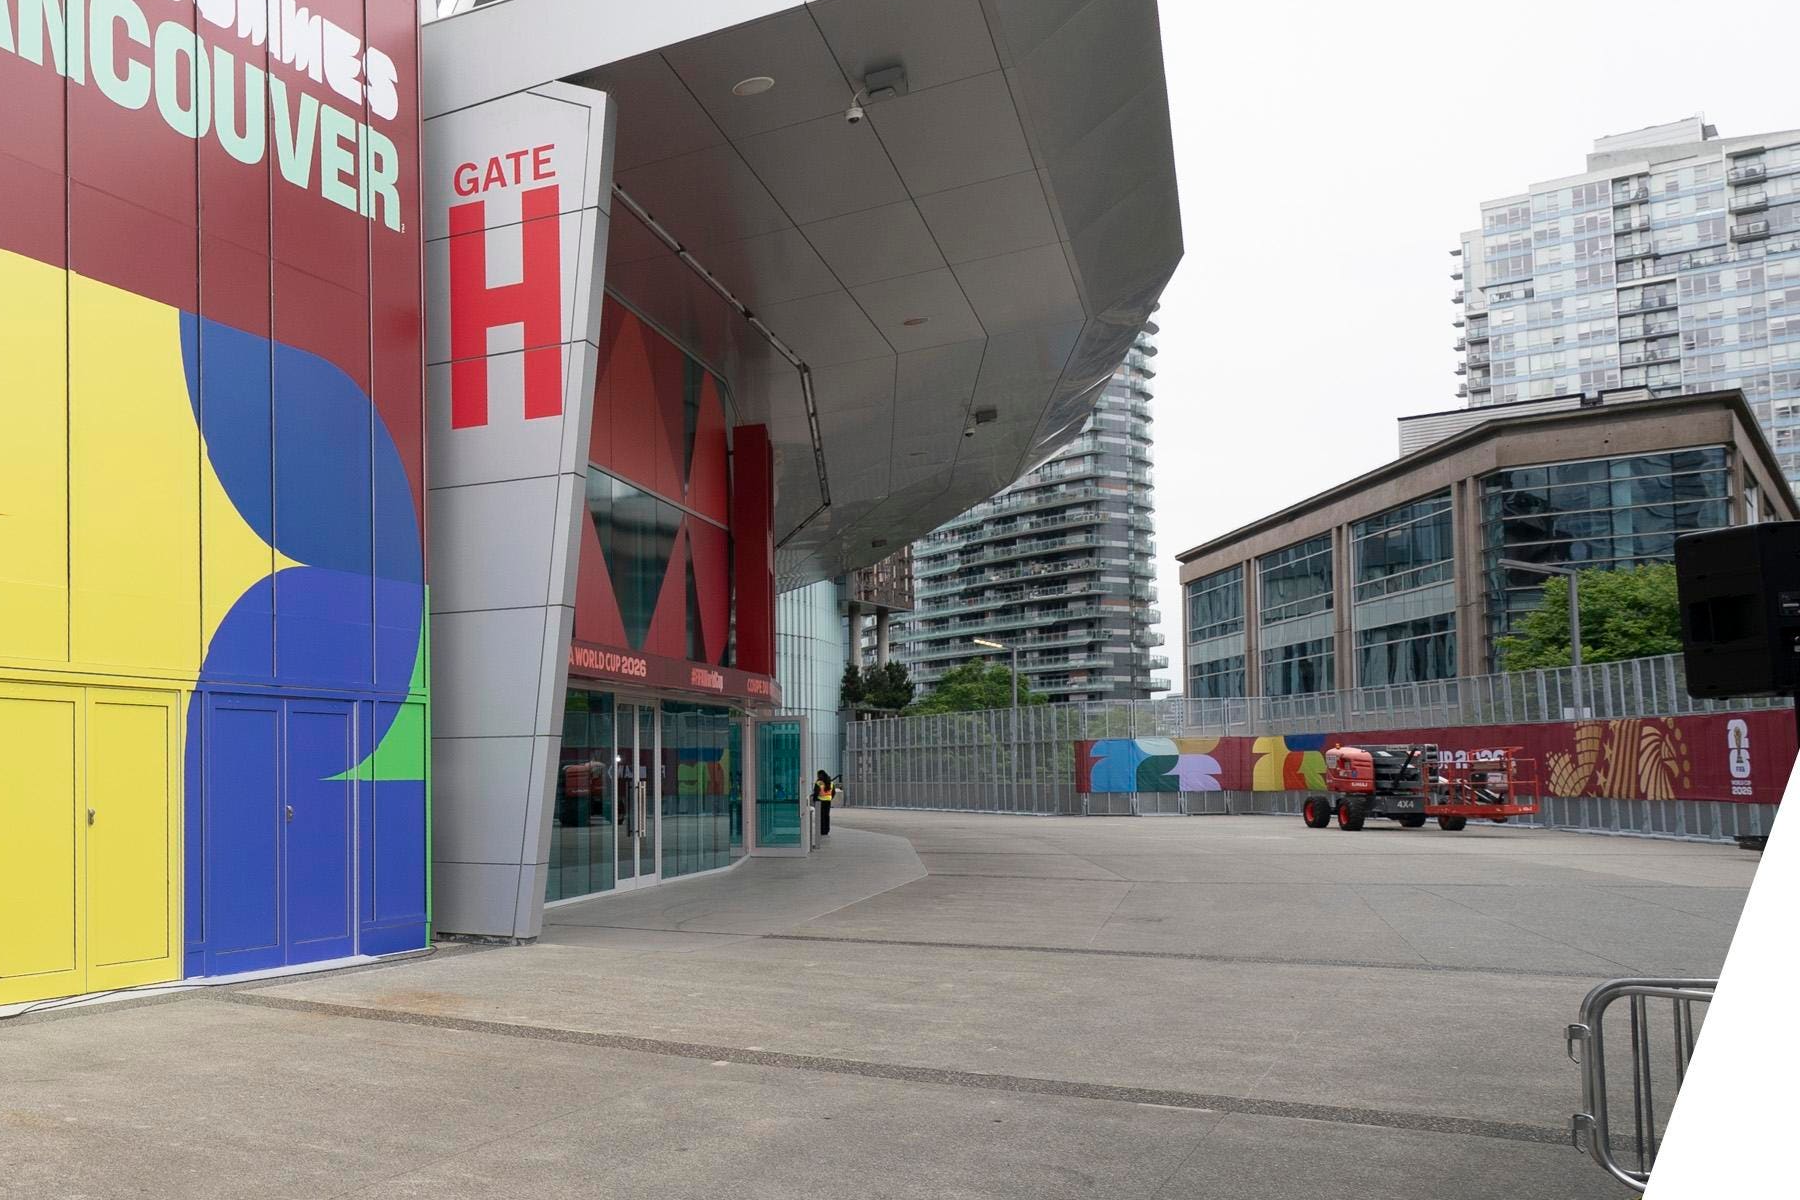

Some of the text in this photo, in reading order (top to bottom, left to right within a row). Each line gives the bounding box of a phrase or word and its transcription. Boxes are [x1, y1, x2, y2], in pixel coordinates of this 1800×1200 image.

[453, 143, 556, 198] GATE
[448, 185, 563, 430] H
[575, 646, 604, 670] WORLD
[605, 652, 621, 673] CUP
[621, 655, 647, 678] 2026
